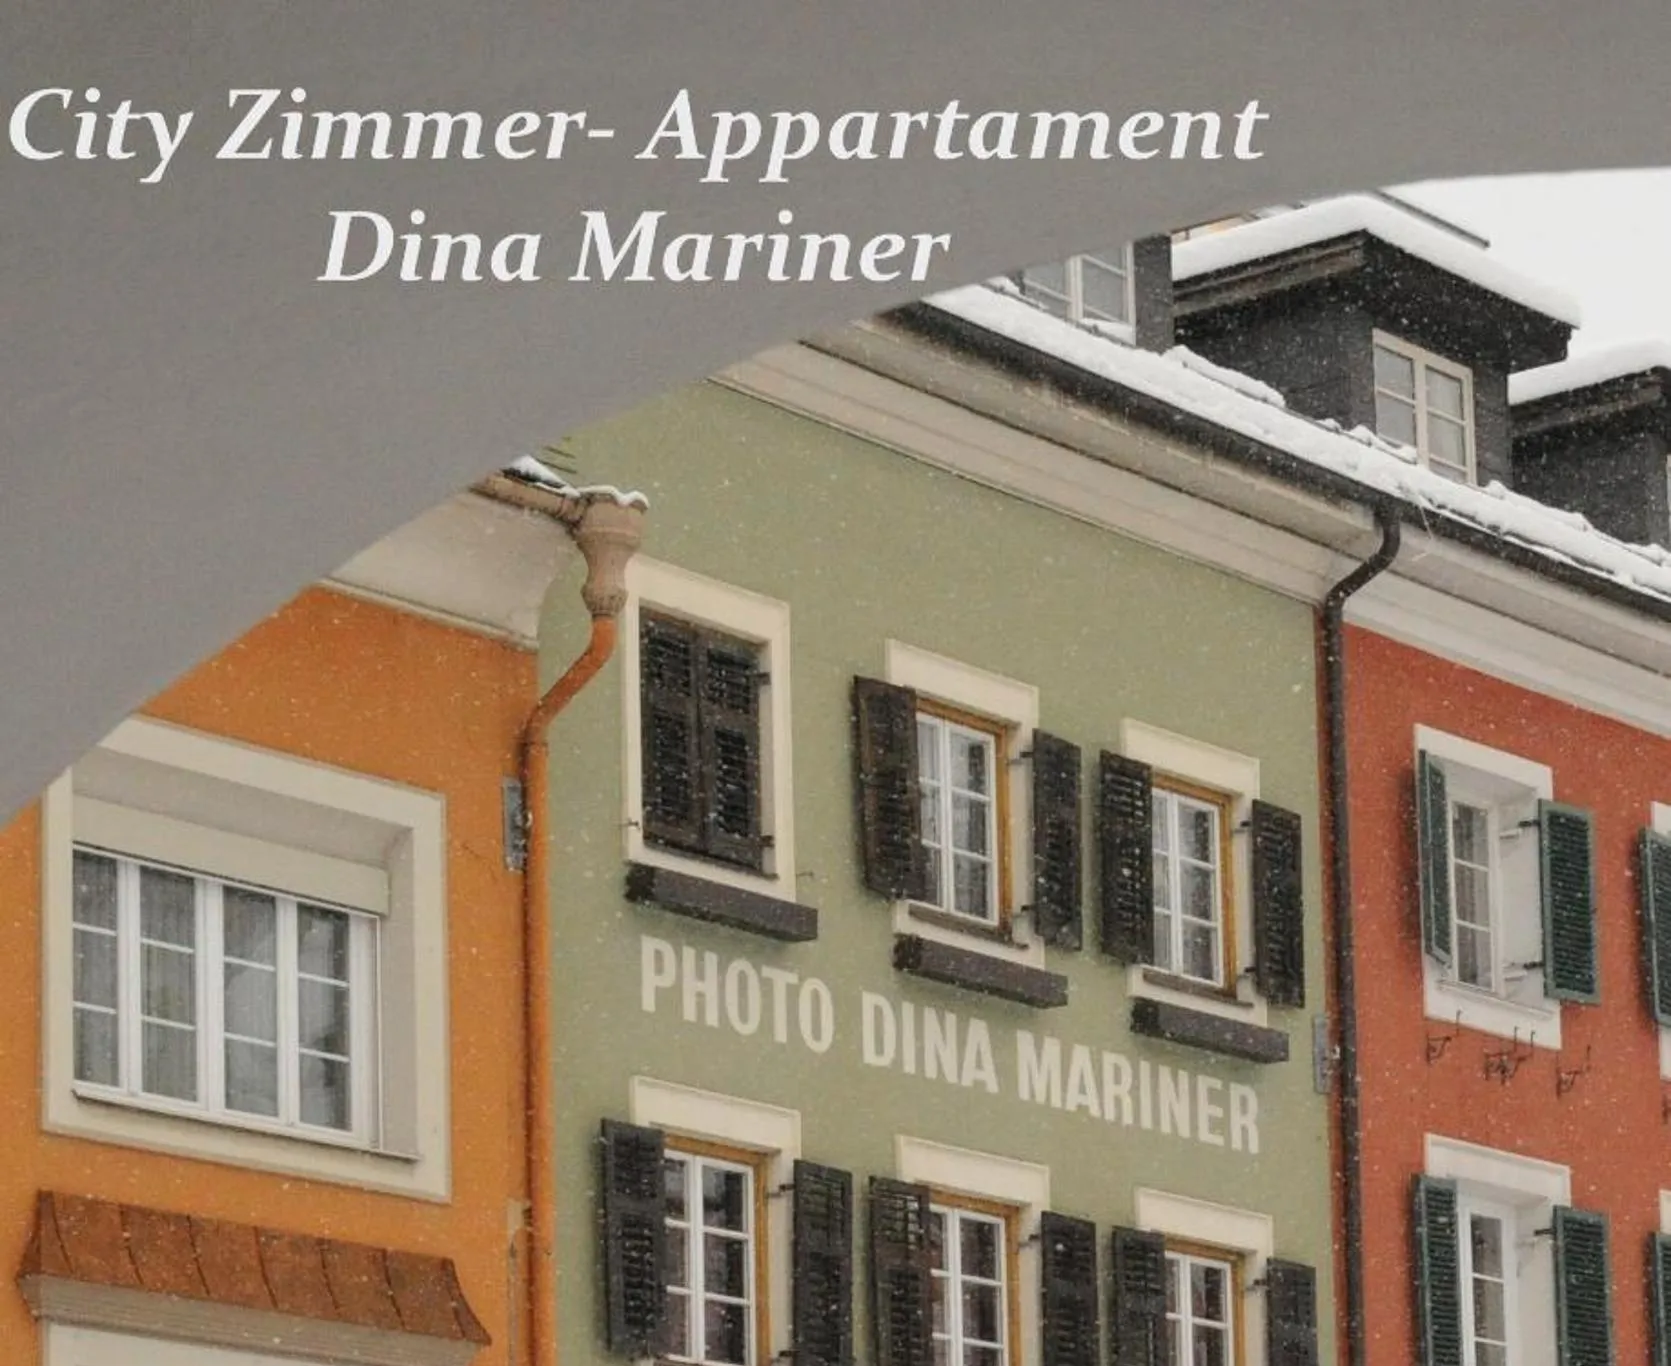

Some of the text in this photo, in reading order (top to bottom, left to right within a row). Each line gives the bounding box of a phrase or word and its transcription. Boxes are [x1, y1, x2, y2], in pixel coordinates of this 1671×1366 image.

[640, 935, 1259, 1154] PHOTO DINA MARINER
